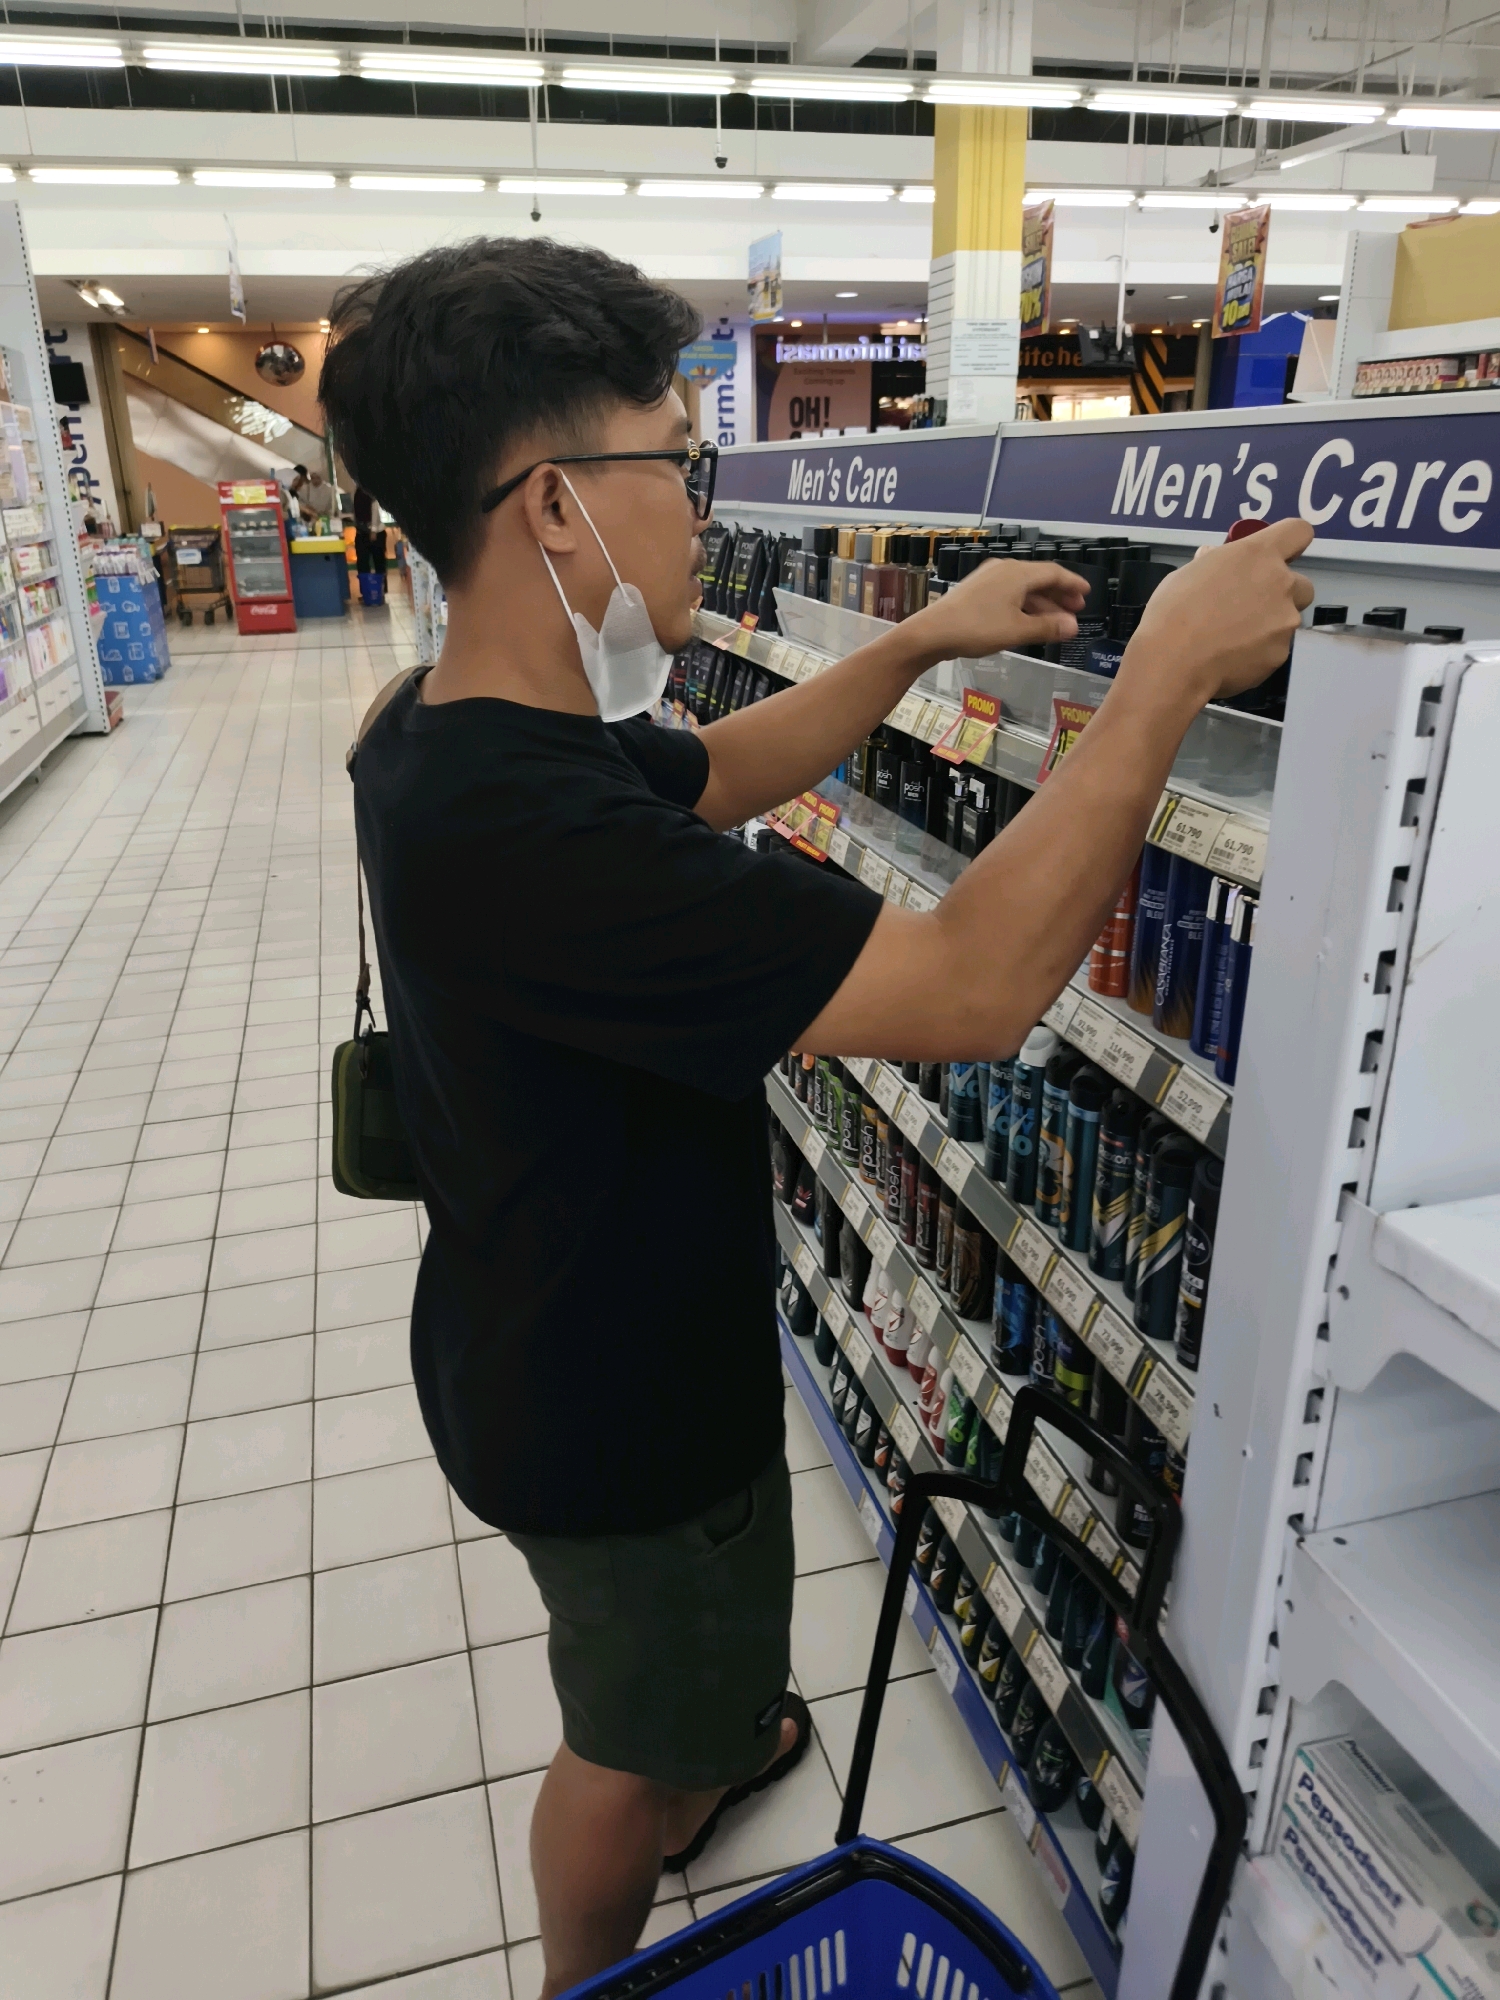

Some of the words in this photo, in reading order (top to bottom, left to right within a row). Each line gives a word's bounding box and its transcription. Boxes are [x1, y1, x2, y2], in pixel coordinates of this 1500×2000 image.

[789, 396, 831, 429] OH!
[786, 457, 842, 503] Men's
[845, 455, 899, 505] Care
[1110, 442, 1279, 521] Men's
[1297, 438, 1494, 534] Care
[1091, 651, 1122, 663] TOTALCAR
[1098, 660, 1113, 669] MEN
[966, 694, 996, 716] PROMO
[876, 768, 893, 782] posh
[904, 780, 925, 794] posh
[818, 802, 836, 820] PROMO
[1146, 909, 1164, 920] BLEU
[1187, 930, 1204, 941] BLE
[813, 1075, 822, 1118] posh
[1013, 1085, 1031, 1100] ona
[842, 1105, 859, 1153] posh
[862, 1124, 878, 1172] posh
[887, 1163, 903, 1212] posh
[1032, 1324, 1053, 1379] posh
[1297, 1771, 1404, 1909] Pepsodent
[1283, 1825, 1385, 1965] Pepsodent
